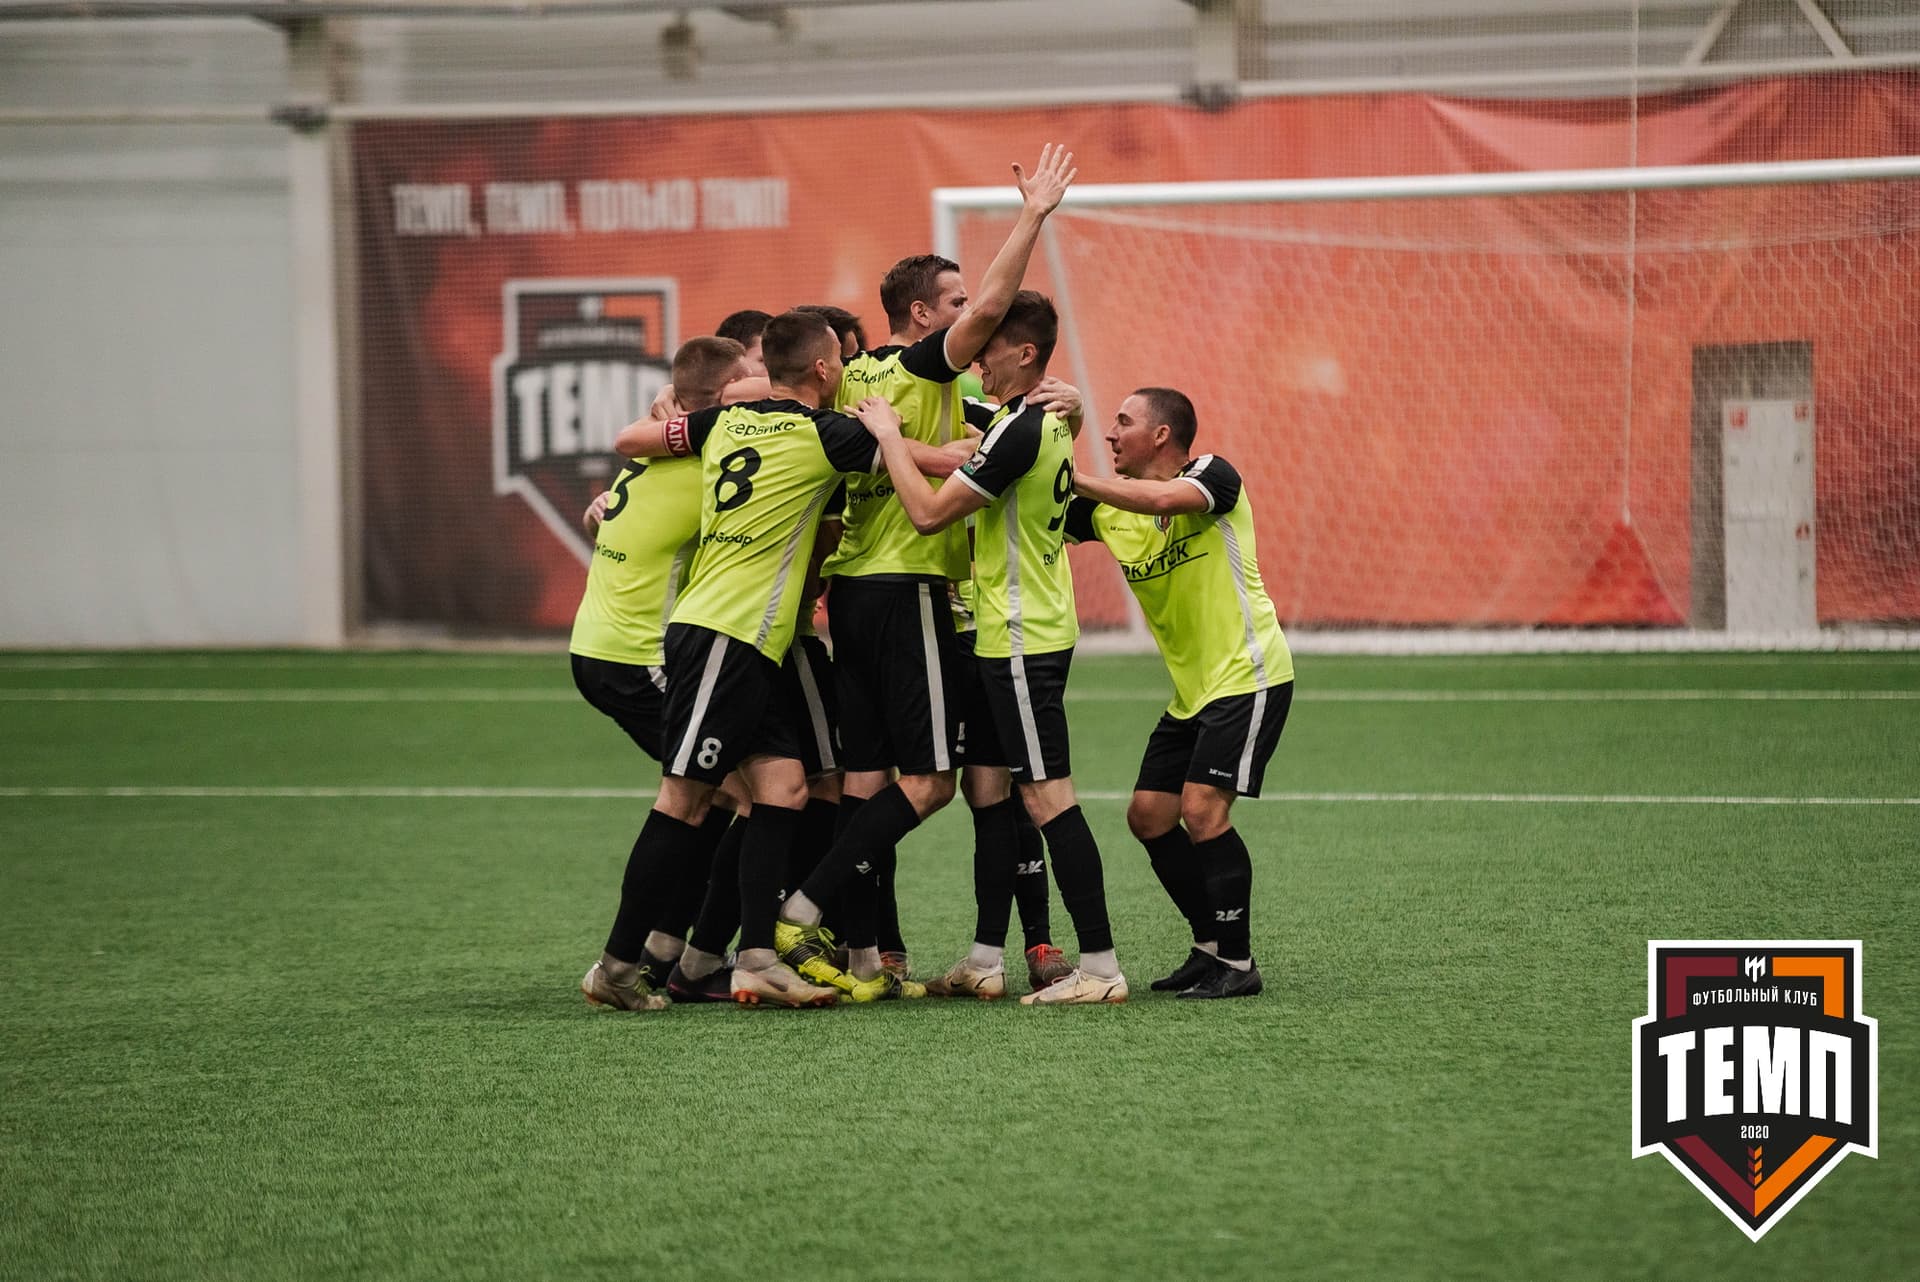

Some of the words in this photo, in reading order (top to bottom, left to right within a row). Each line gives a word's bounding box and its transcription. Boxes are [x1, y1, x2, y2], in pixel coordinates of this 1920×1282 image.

[714, 446, 762, 513] 8
[1120, 542, 1189, 578] РКУТСК
[697, 737, 723, 770] 8
